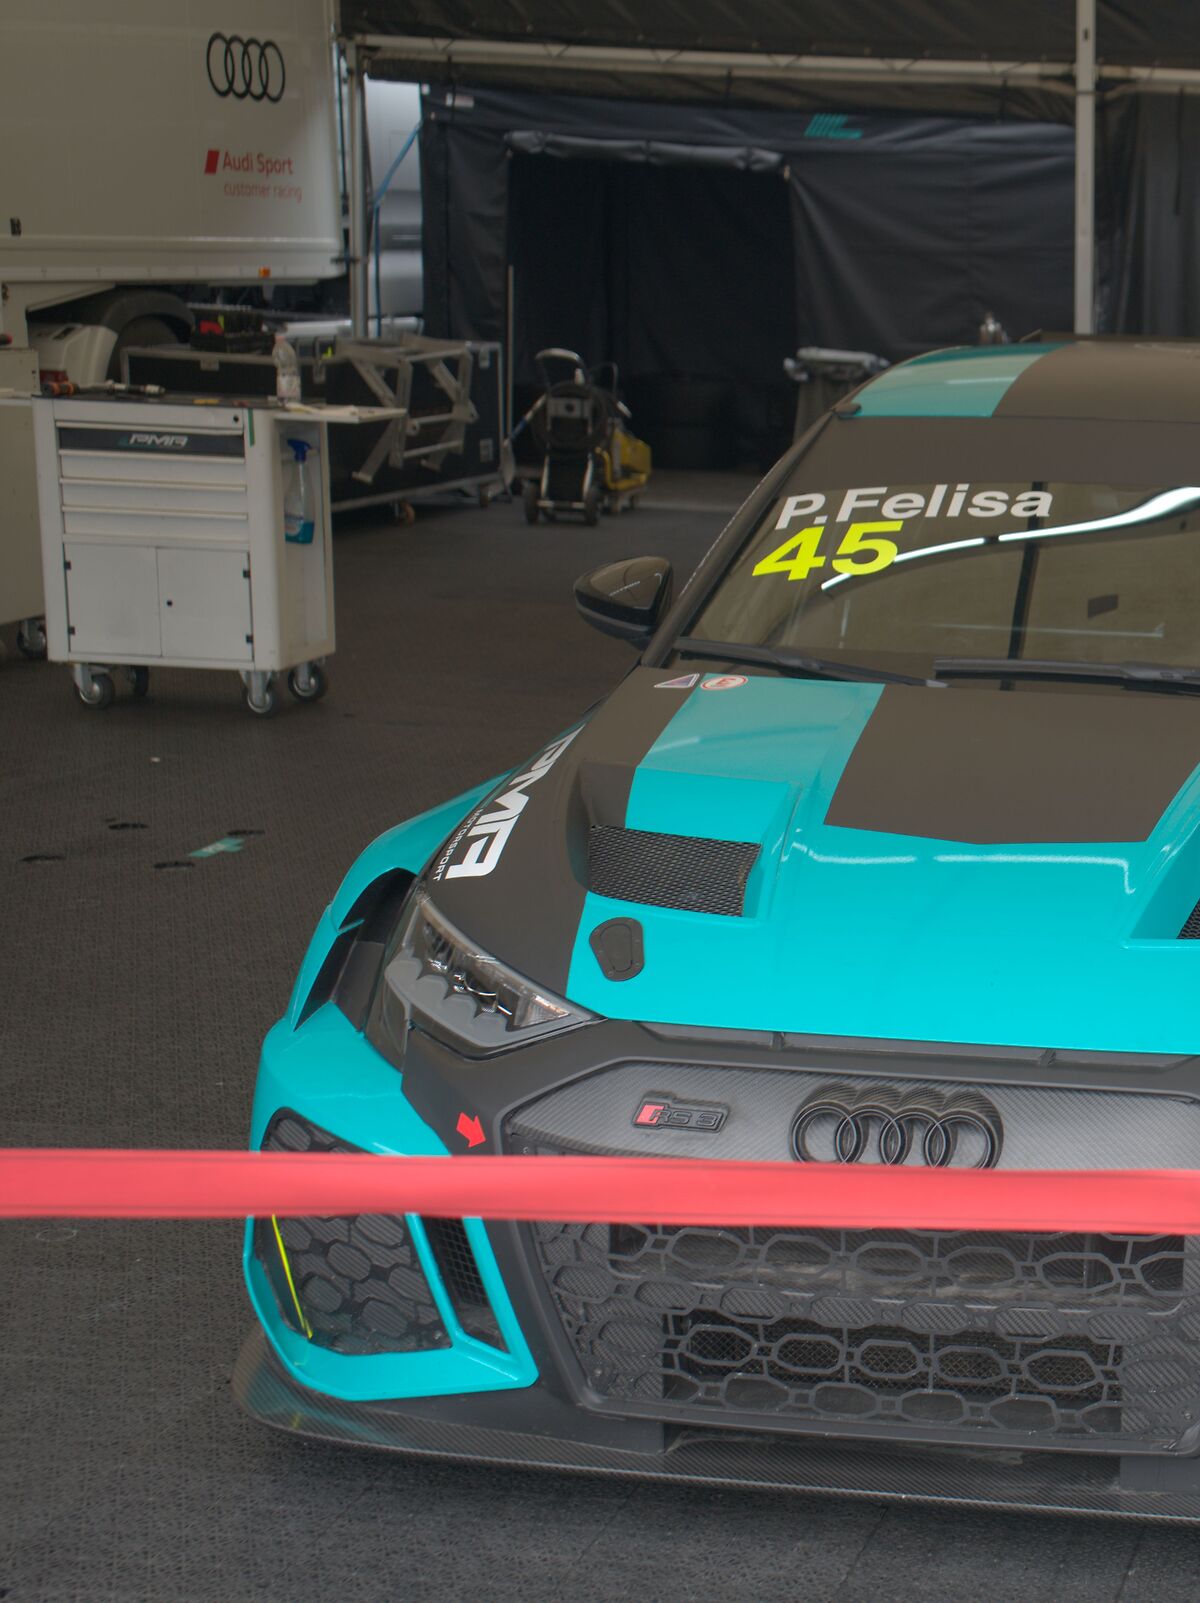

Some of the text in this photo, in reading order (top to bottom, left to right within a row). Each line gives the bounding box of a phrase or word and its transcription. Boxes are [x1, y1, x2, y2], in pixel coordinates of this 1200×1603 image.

[223, 151, 294, 177] Audi Sport
[224, 182, 303, 204] customer racing
[775, 483, 1054, 530] P.Felisa
[752, 520, 904, 581] 45
[646, 1108, 718, 1127] RS 3
